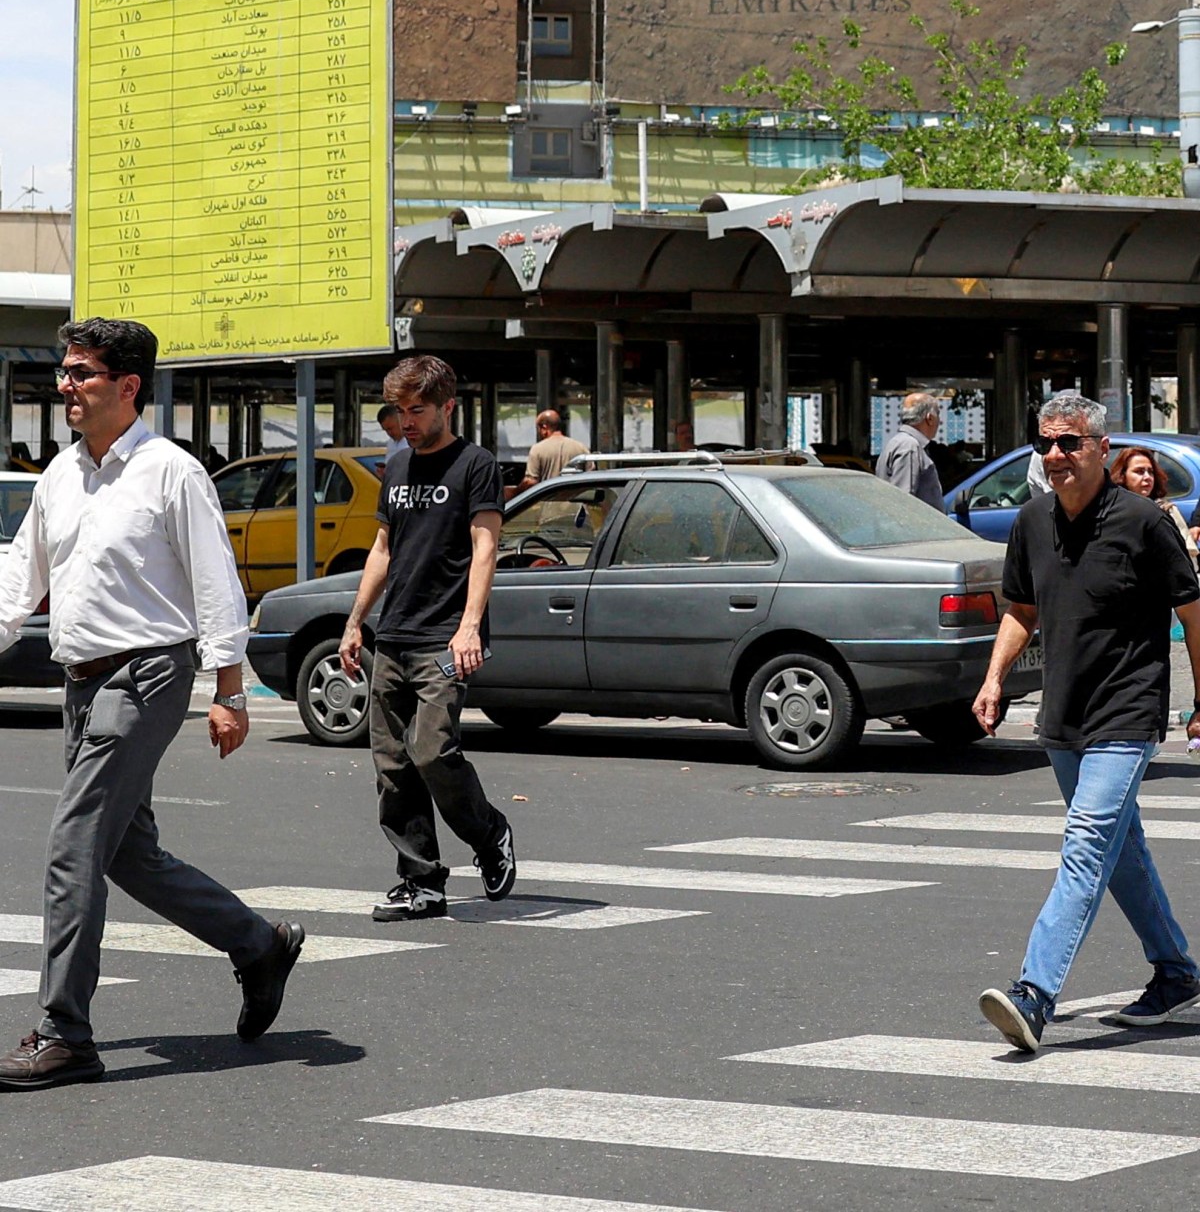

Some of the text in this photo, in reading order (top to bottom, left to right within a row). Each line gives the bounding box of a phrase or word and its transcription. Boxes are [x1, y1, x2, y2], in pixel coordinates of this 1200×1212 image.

[222, 9, 268, 24] سعادت آباد
[245, 26, 267, 37] پونک
[211, 45, 266, 60] میدان صنعت
[256, 61, 266, 76] پل
[213, 81, 266, 100] میدان آزادی
[241, 100, 266, 113] توحید
[209, 121, 267, 136] دهکده المپیک
[228, 137, 267, 155] کوی نصر
[231, 156, 267, 172] جمهوری
[248, 174, 266, 191] کرج
[204, 195, 267, 213] فلکه اول شهران
[240, 216, 267, 230] اکباتان
[230, 234, 267, 247] جنت آباد
[211, 251, 268, 268] میدان فاطمی
[214, 271, 268, 285] میدان انقلاب
[207, 295, 234, 305] یوسف
[236, 289, 268, 304] دوراهی
[259, 336, 290, 347] مدیریت
[388, 485, 450, 504] KENZO
